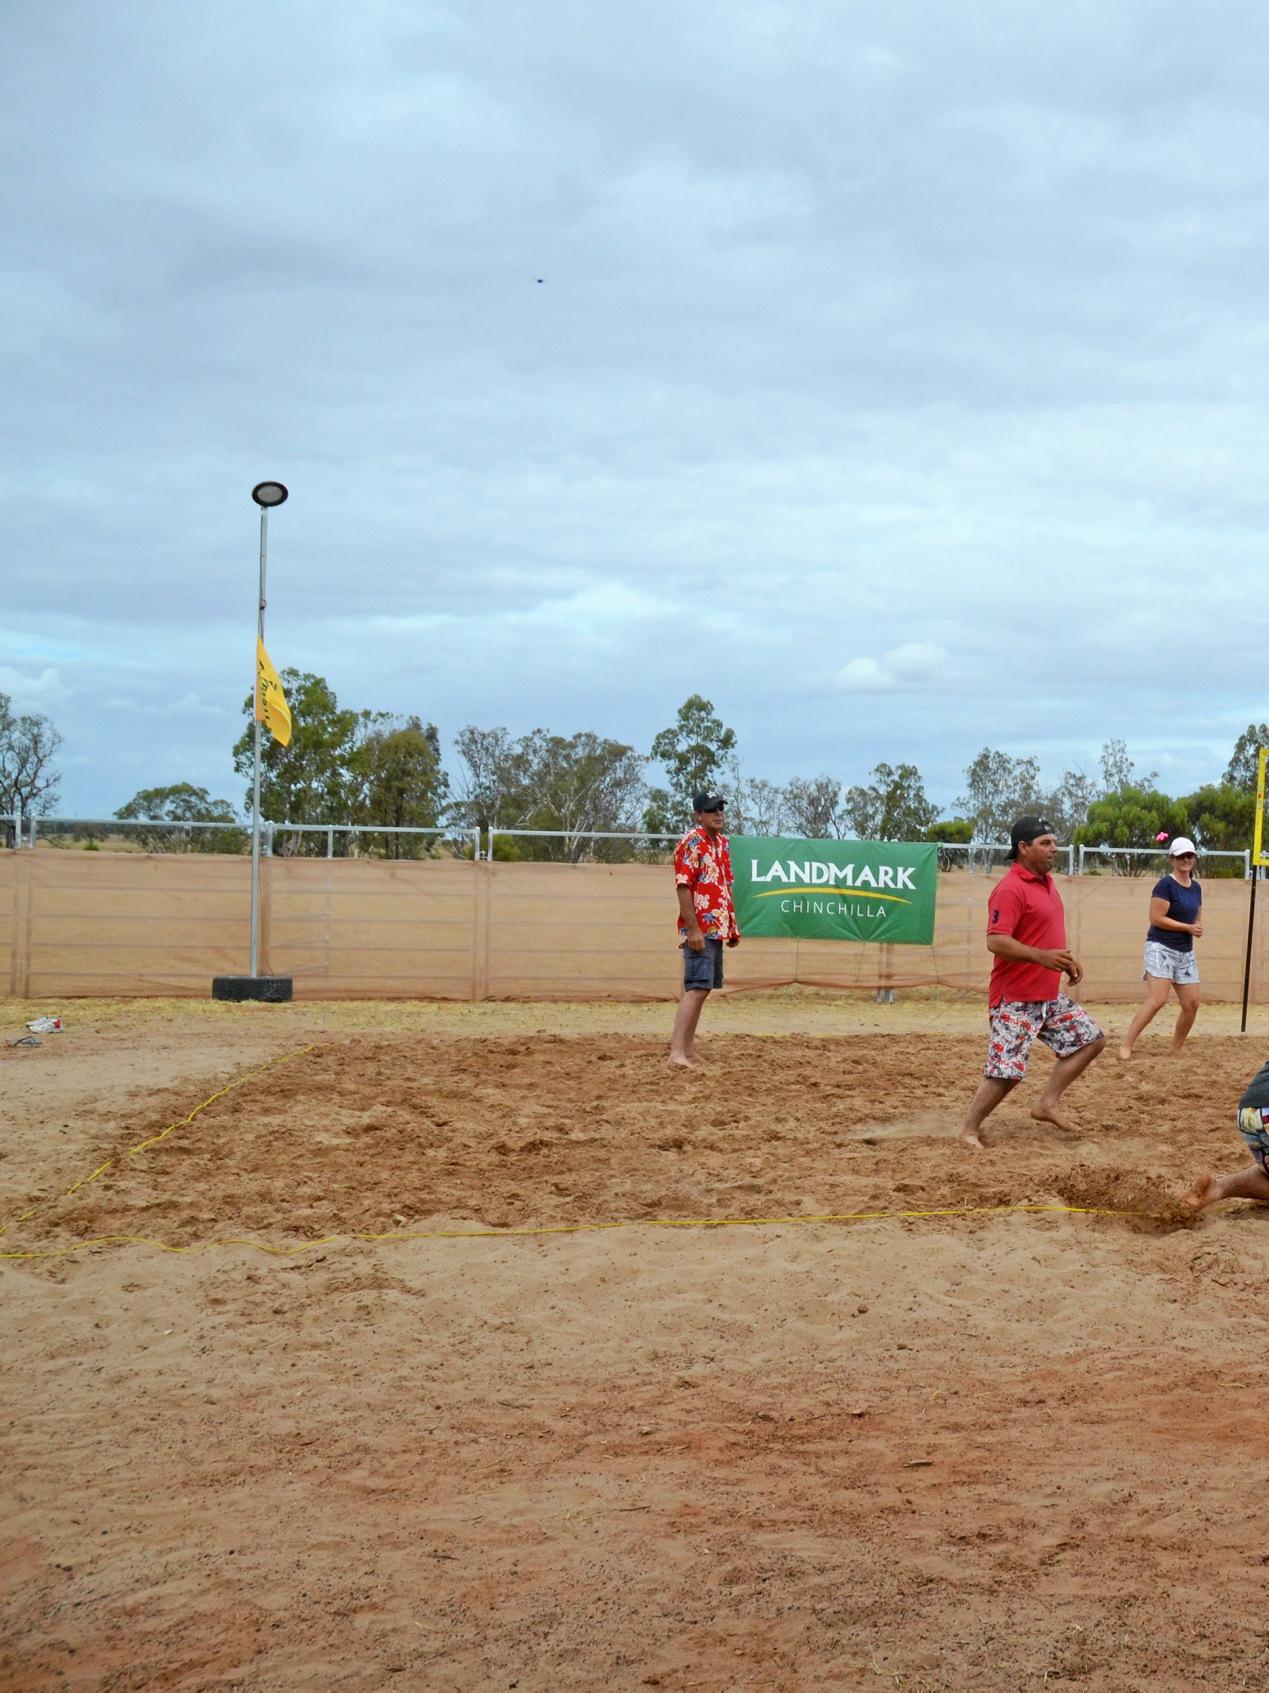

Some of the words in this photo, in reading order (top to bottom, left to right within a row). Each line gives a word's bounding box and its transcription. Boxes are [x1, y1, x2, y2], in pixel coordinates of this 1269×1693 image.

[751, 859, 917, 890] LANDMARK
[780, 900, 887, 918] CHINCHILLA
[992, 909, 1000, 924] 3
